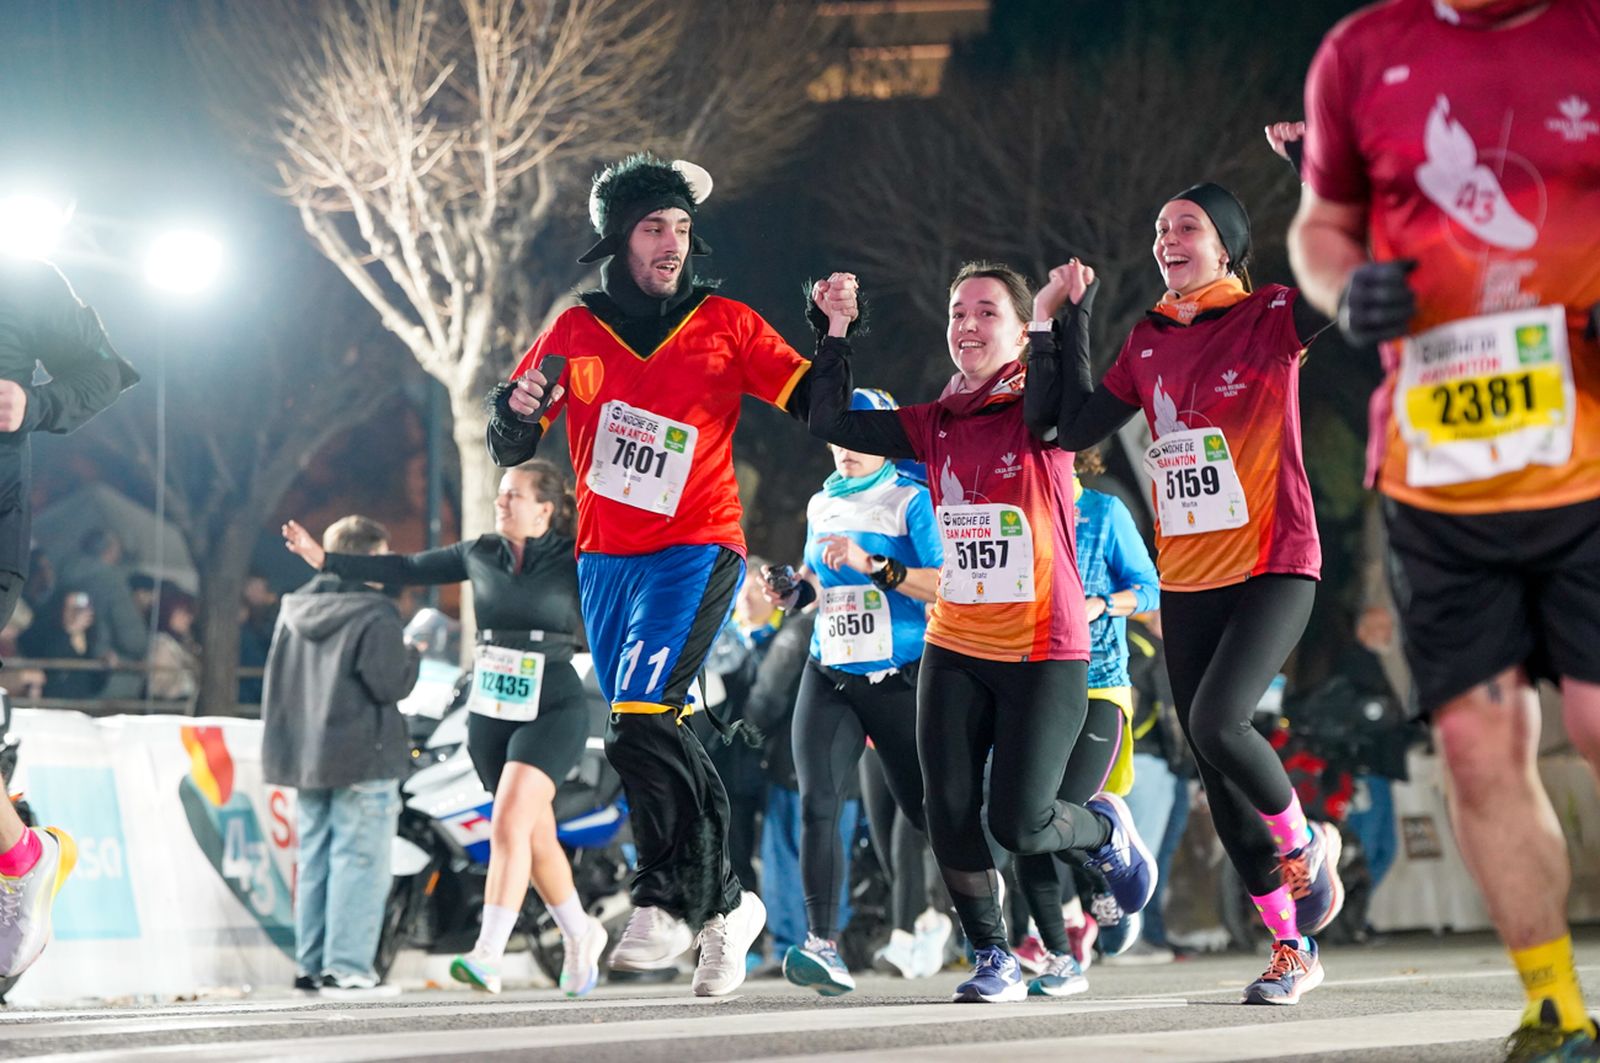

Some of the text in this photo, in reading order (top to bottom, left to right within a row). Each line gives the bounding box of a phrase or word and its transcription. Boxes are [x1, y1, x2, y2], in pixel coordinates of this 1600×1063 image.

[1457, 182, 1497, 225] 43
[571, 361, 595, 396] 11
[1432, 372, 1536, 427] 2381
[608, 422, 626, 436] SAN
[645, 422, 659, 433] DE
[612, 437, 669, 479] 7601
[1161, 443, 1184, 455] NOCHE
[1184, 441, 1194, 453] DE
[1166, 466, 1220, 500] 5159
[946, 528, 959, 539] SAN
[952, 515, 991, 526] NOCHE DE
[955, 540, 1009, 570] 5157
[828, 612, 875, 638] 3650
[621, 639, 671, 695] 11
[482, 671, 530, 698] 12435
[222, 816, 277, 917] 43
